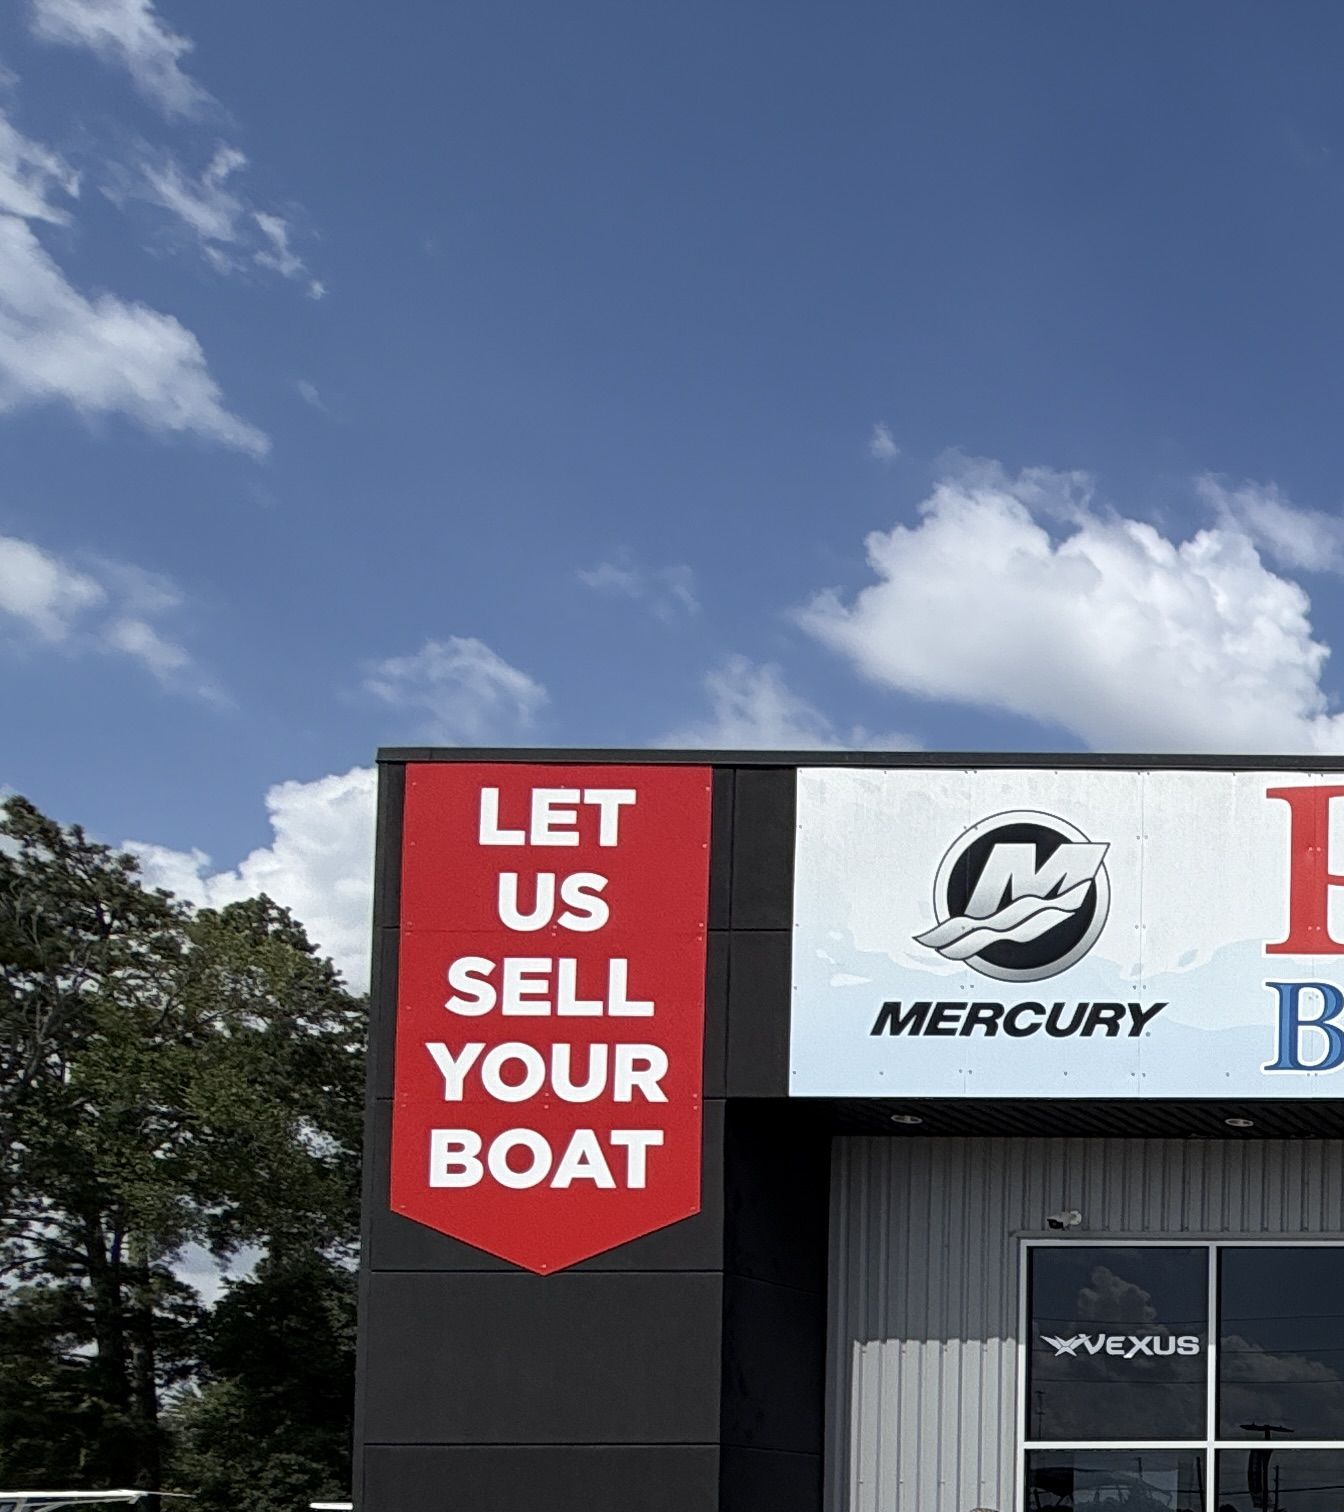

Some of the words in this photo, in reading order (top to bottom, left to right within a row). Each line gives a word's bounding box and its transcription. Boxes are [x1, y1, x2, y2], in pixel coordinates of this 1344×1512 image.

[478, 786, 637, 848] LET
[498, 871, 610, 933] US
[444, 956, 655, 1018] SELL
[869, 1001, 1170, 1038] MERCURY
[424, 1041, 671, 1104] YOUR
[427, 1127, 665, 1189] BOAT
[1077, 1333, 1200, 1359] VEXUS
